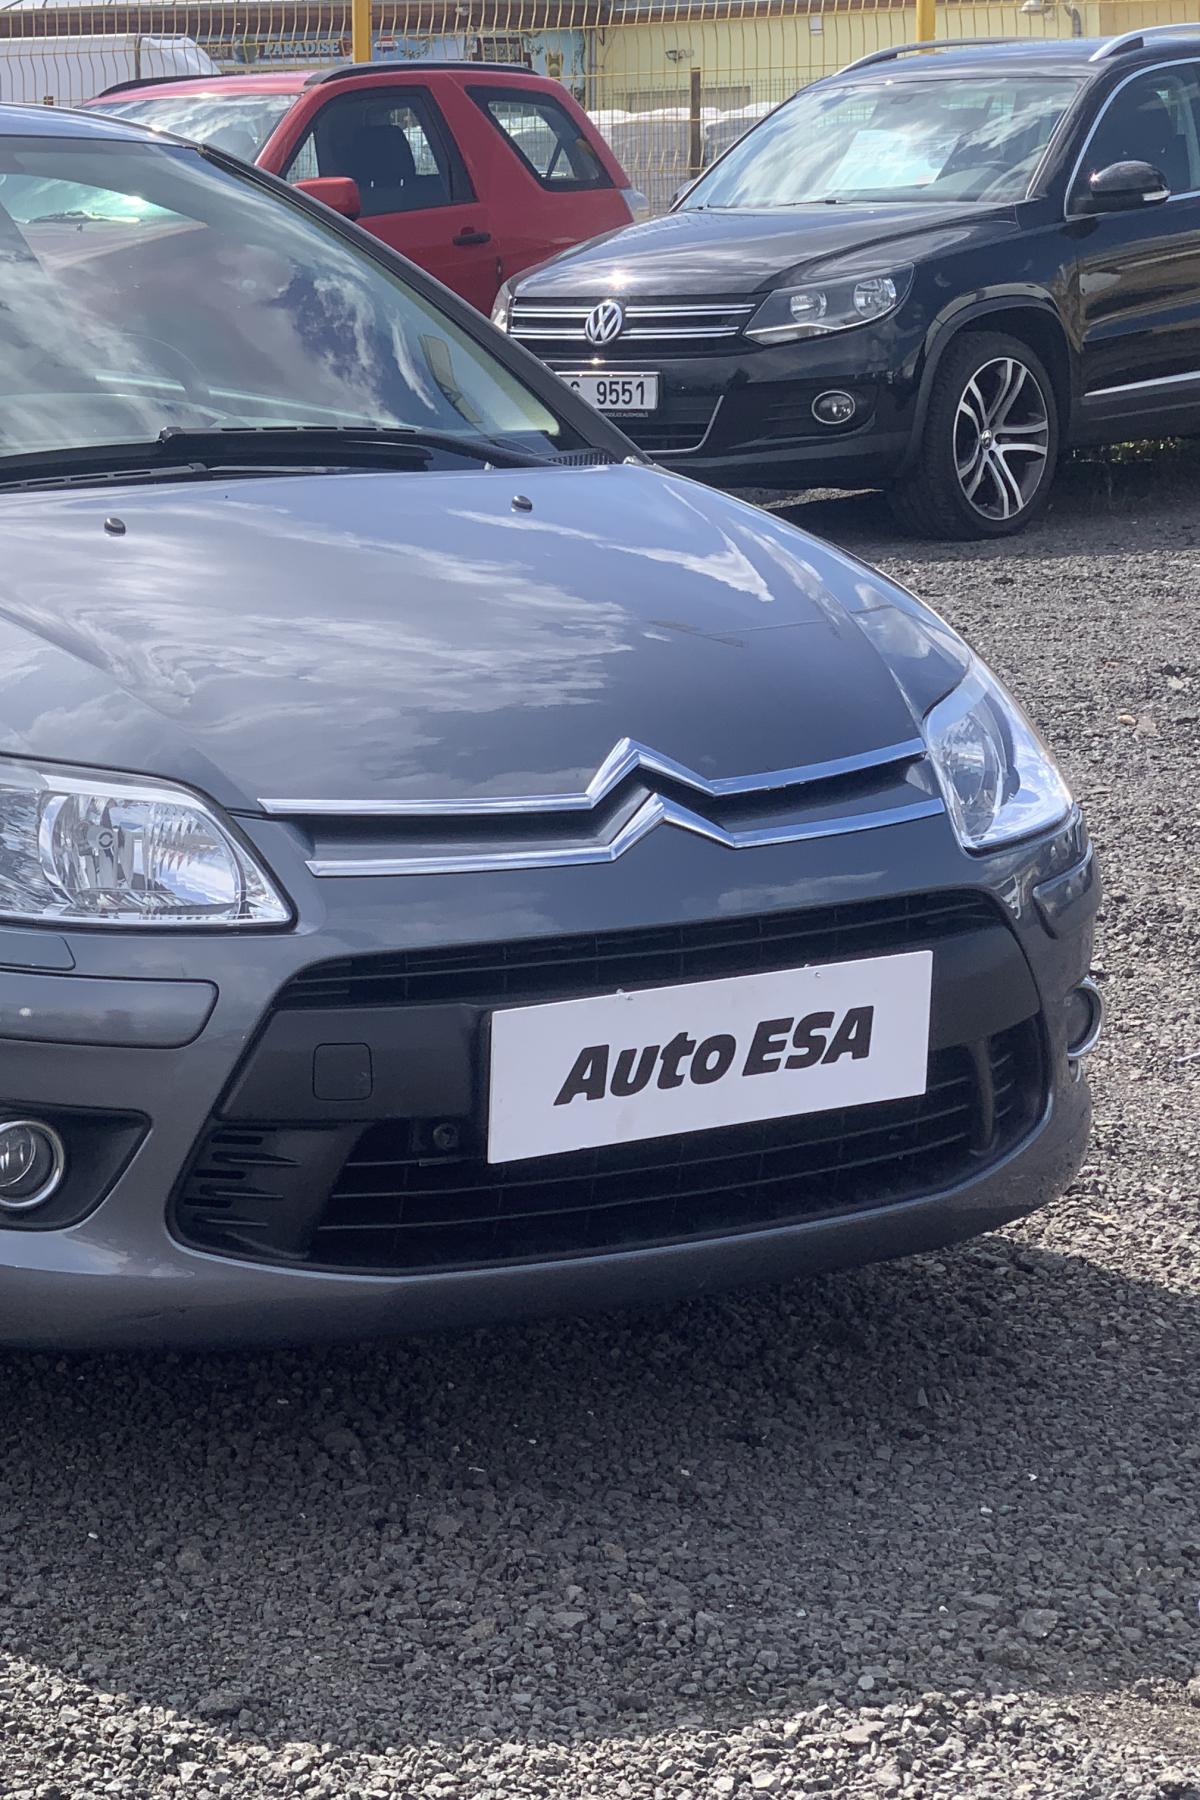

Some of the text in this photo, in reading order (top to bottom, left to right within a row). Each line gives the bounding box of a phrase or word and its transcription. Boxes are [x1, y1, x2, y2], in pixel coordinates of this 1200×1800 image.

[263, 40, 340, 56] PARADISE
[596, 380, 645, 406] 9551
[552, 1005, 875, 1106] Auto ESA
